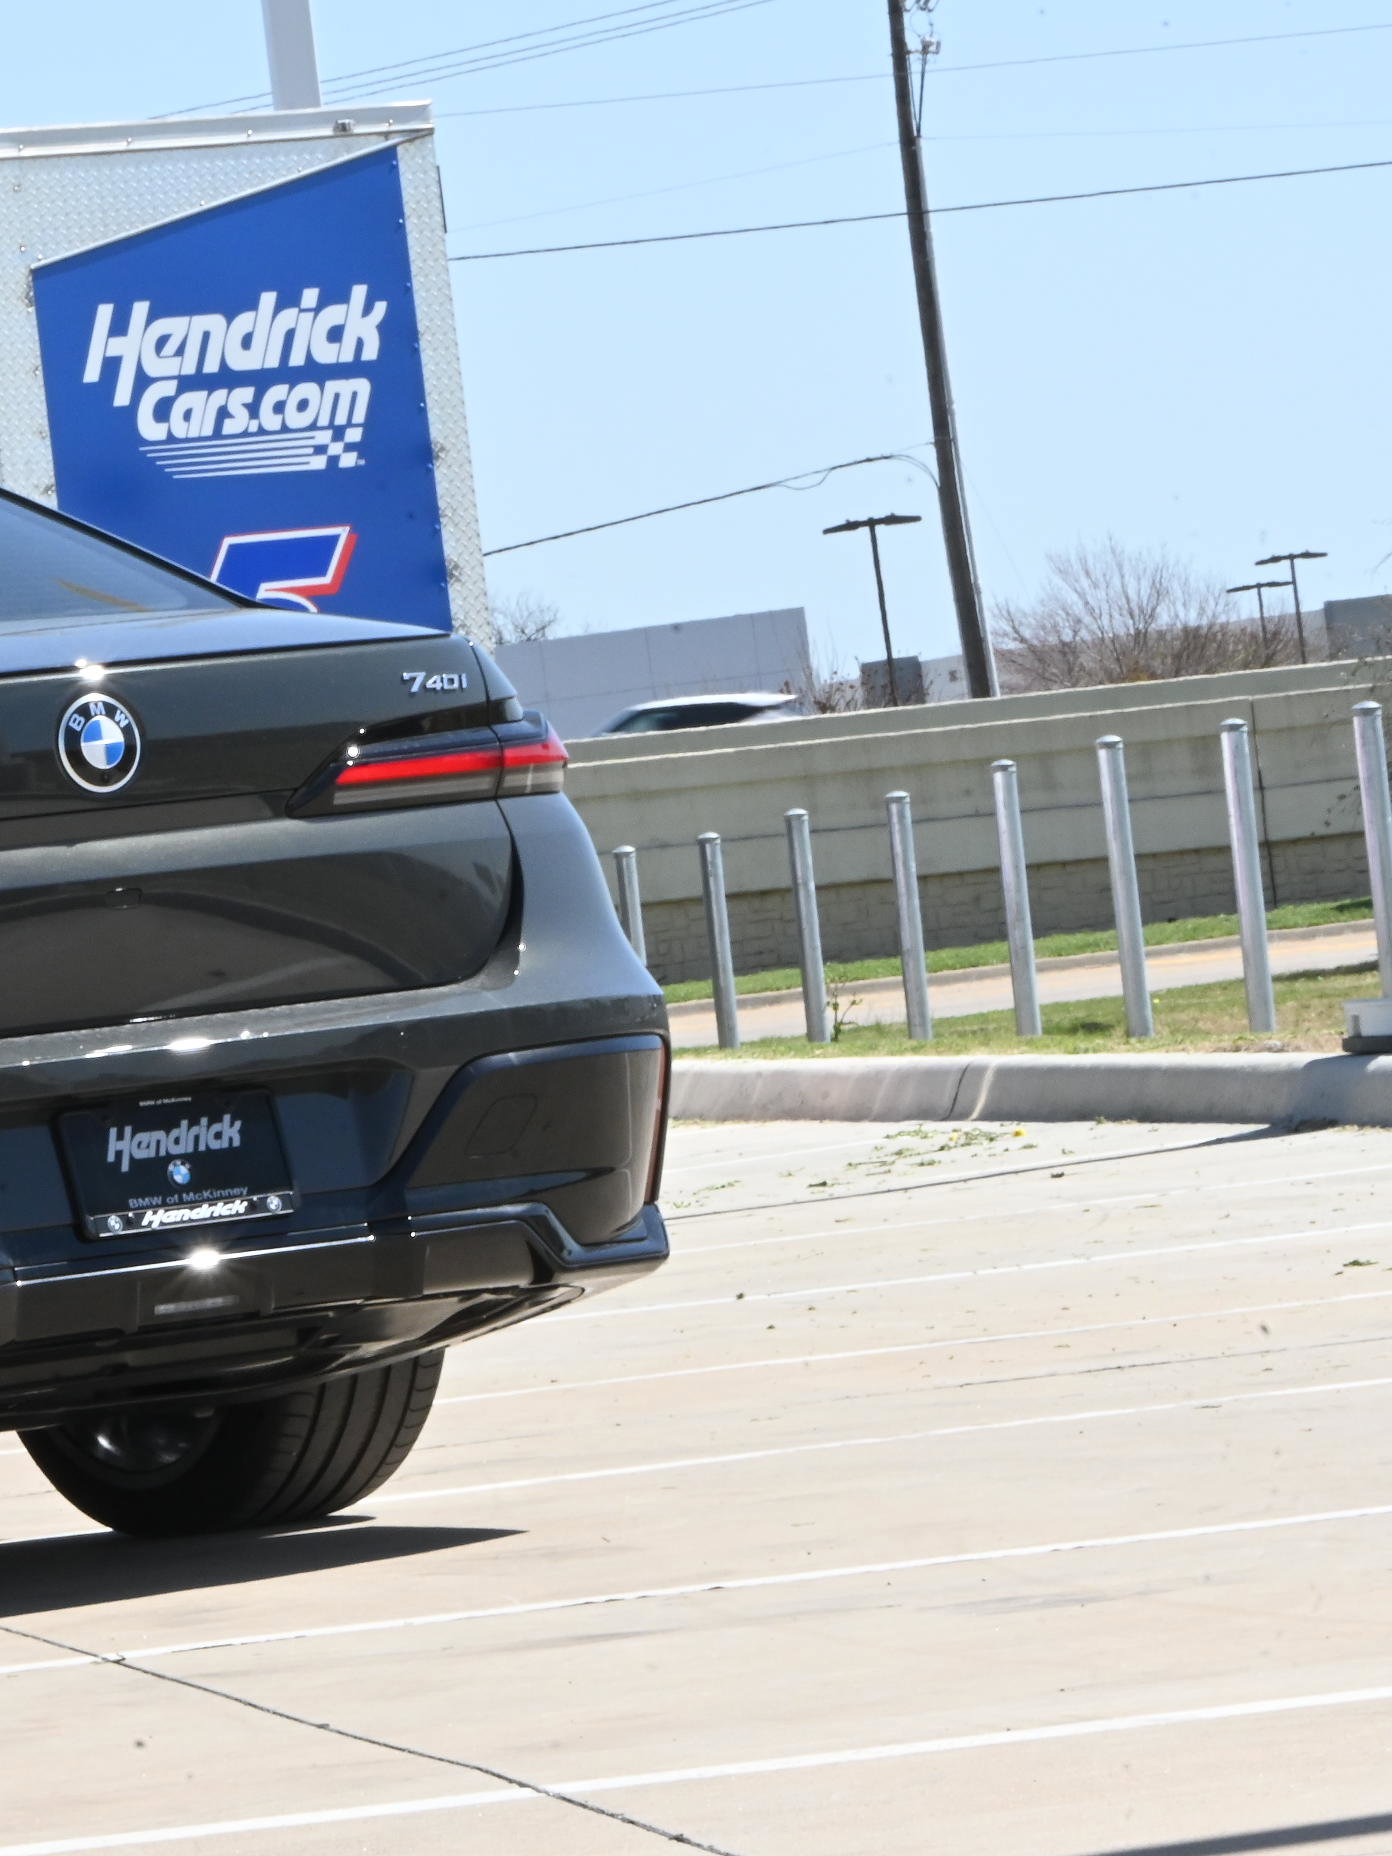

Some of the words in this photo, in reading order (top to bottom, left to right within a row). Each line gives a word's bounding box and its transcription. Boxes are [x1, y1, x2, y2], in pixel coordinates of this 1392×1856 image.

[83, 284, 388, 407] Hendrick
[137, 377, 372, 441] Cars.com
[69, 701, 129, 732] BMW
[107, 1113, 243, 1173] Hendrick
[128, 1196, 162, 1209] BMW
[166, 1194, 179, 1204] of
[182, 1186, 248, 1202] McKinney
[141, 1199, 248, 1229] Hendrick
